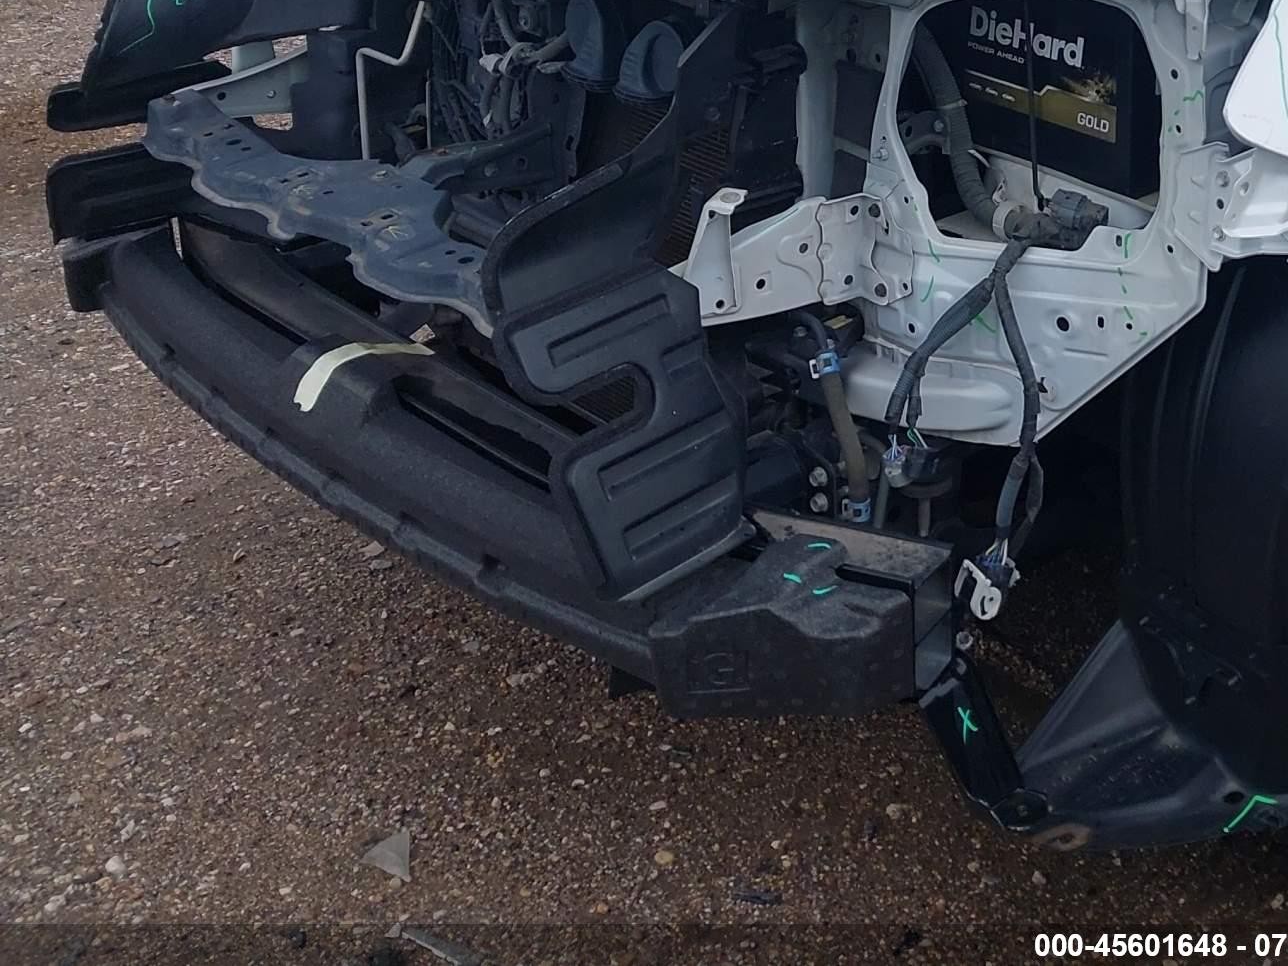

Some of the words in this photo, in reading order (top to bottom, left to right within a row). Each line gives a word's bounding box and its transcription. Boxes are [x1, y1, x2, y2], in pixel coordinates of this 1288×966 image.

[970, 6, 1085, 68] DieHard
[996, 50, 1025, 64] AHEAD
[1077, 112, 1110, 133] GOLD
